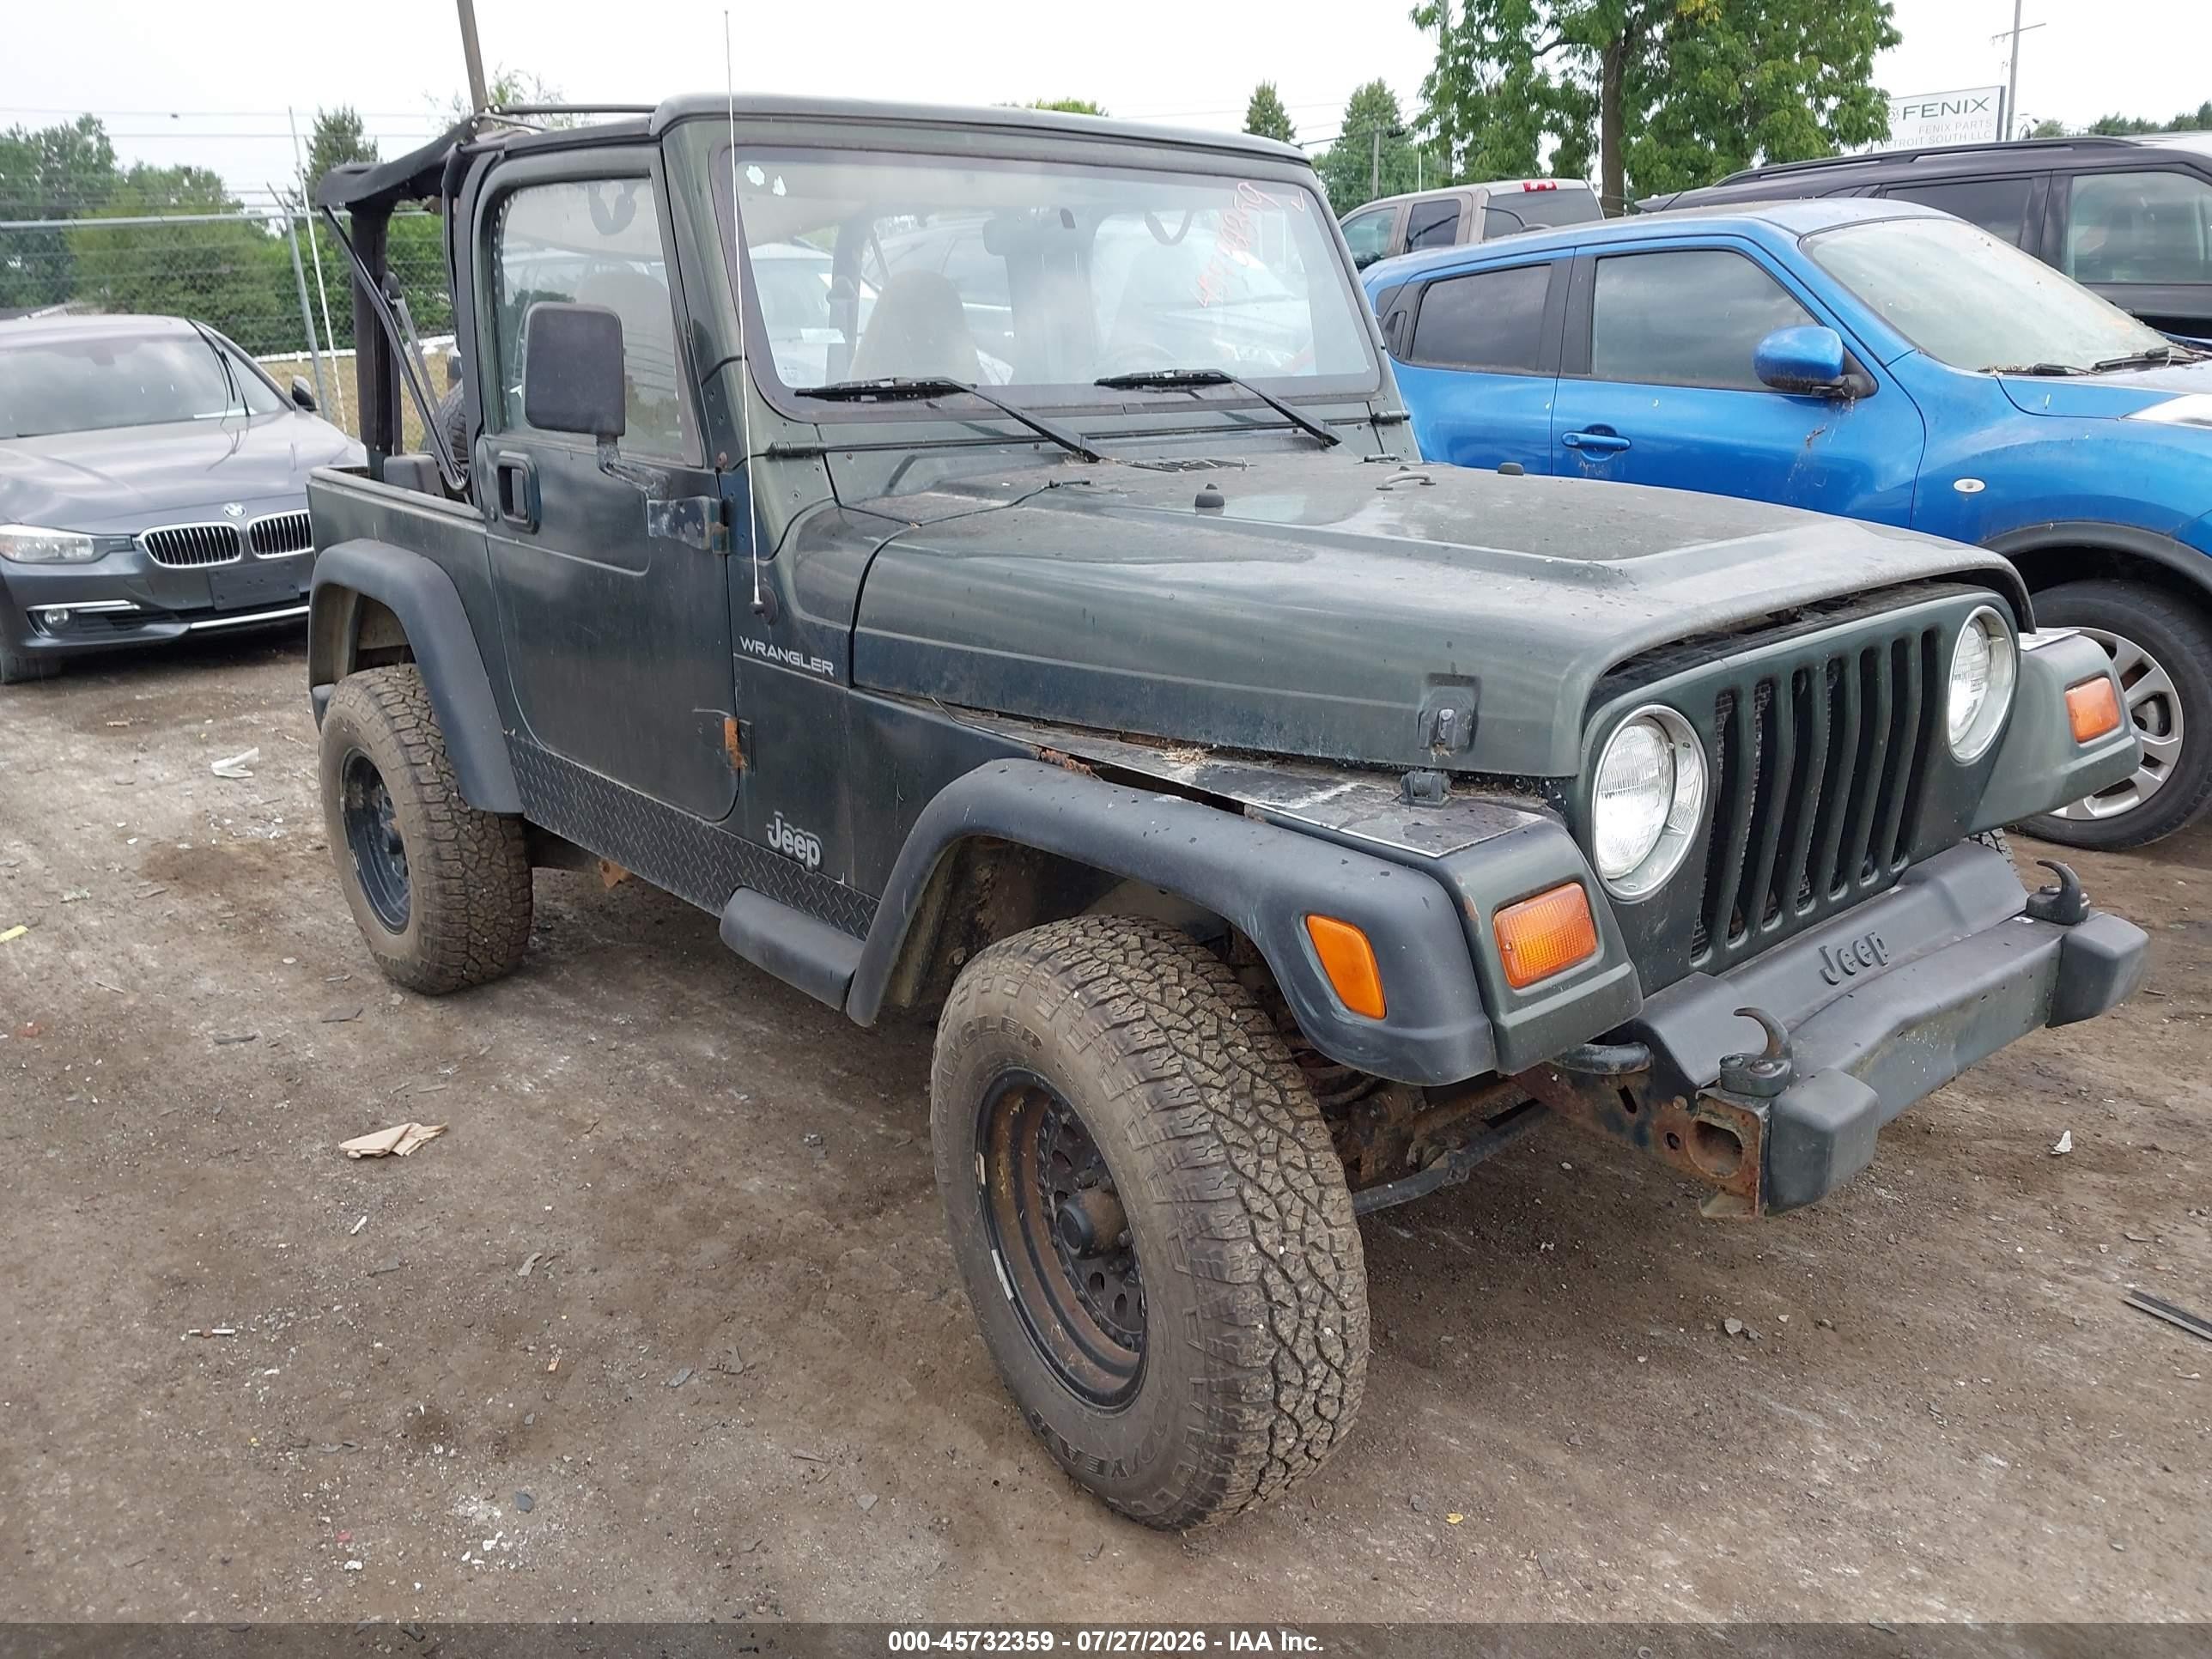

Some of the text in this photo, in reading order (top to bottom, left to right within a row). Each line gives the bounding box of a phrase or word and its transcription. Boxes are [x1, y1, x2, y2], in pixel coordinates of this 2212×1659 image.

[1902, 96, 1990, 121] FENIX
[1919, 118, 1993, 136] FENIX PARTS
[1929, 133, 1966, 144] SOUTH
[1971, 130, 1992, 141] LLC
[739, 635, 835, 677] WRANGLER
[766, 812, 823, 868] Jeep
[1818, 932, 1889, 986] Jeep
